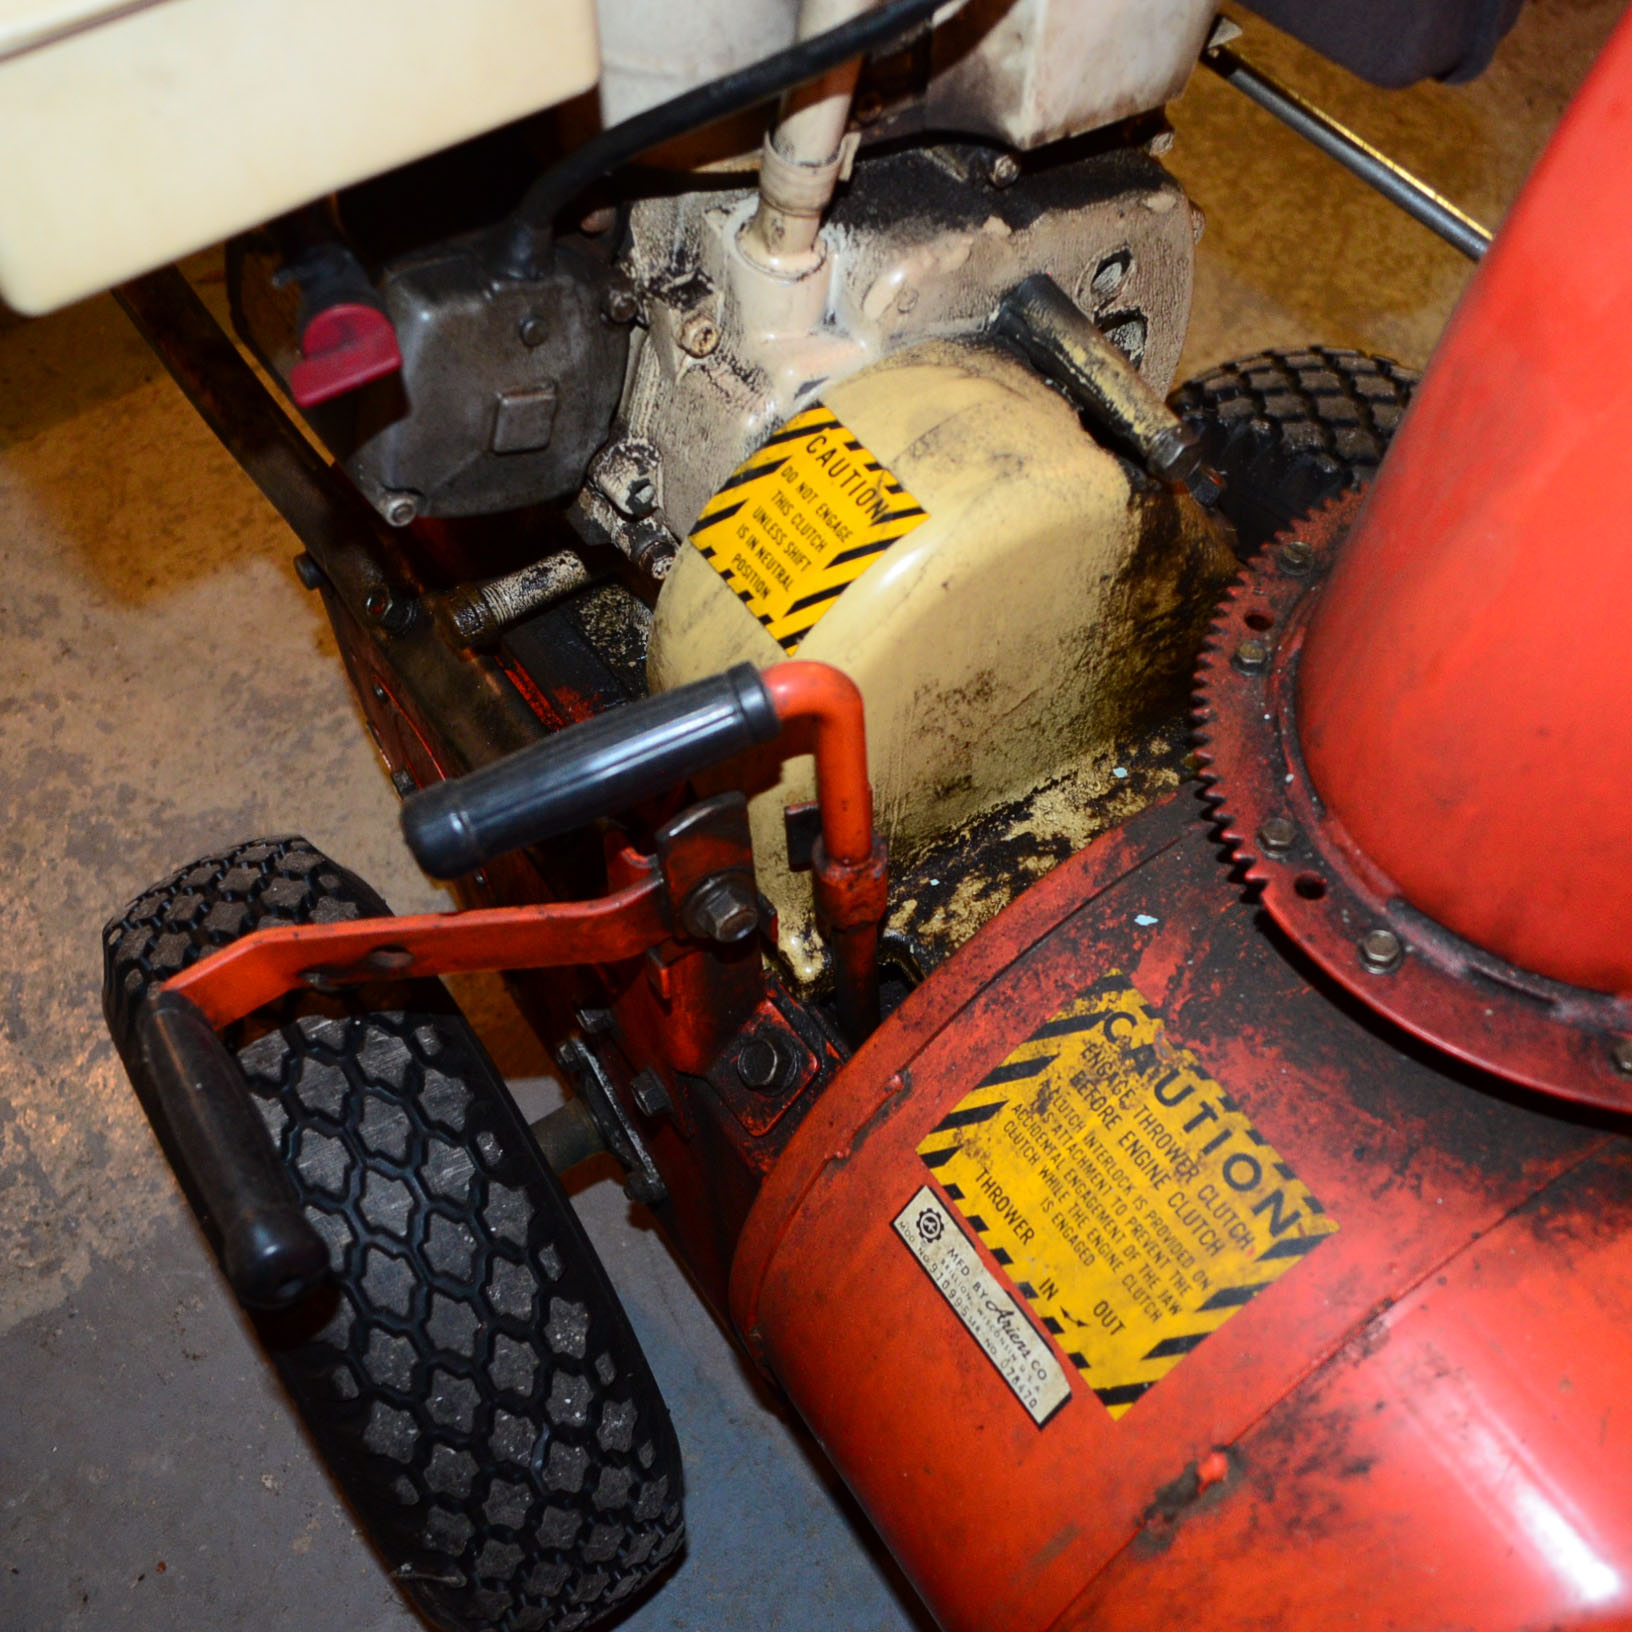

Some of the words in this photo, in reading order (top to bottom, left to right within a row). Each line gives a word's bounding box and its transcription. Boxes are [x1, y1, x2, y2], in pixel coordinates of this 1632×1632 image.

[779, 463, 800, 485] DO
[794, 480, 819, 506] NOT
[813, 501, 854, 544] ENGAGE
[805, 434, 891, 521] CAUTION
[734, 523, 750, 540] IS
[744, 533, 760, 551] IN
[753, 545, 796, 592] NEUTRAL
[750, 504, 789, 546] UNLESS
[782, 540, 812, 572] SHIFT
[769, 489, 795, 516] THIS
[788, 510, 829, 554] CLUTCH
[729, 552, 773, 600] POSITION
[1067, 1068, 1123, 1131] BEFORE
[1117, 1128, 1172, 1192] ENGINE
[1165, 1188, 1225, 1258] CLUTCH
[1079, 1040, 1141, 1112] ENGAGE
[1131, 1103, 1201, 1186] THROWER
[1195, 1181, 1257, 1252] CLUTCH
[1103, 1011, 1302, 1238] CAUTION
[971, 1166, 1036, 1246] THROWER
[1001, 1118, 1042, 1167] CLUTCH
[1036, 1164, 1070, 1203] WHILE
[1065, 1202, 1090, 1229] THE
[1085, 1227, 1124, 1273] ENGINE
[1120, 1272, 1163, 1324] CLUTCH
[1010, 1100, 1069, 1171] ACCIDENTAL
[1061, 1167, 1127, 1246] ENGAGEMENT
[1121, 1243, 1141, 1264] OF
[1136, 1263, 1161, 1289] THE
[1156, 1288, 1183, 1318] JAW
[1038, 1196, 1055, 1214] IS
[1049, 1211, 1097, 1268] ENGAGED
[1047, 1088, 1087, 1134] CLUTCH
[1080, 1129, 1138, 1198] INTERLOCK
[1131, 1193, 1149, 1211] IS
[1143, 1208, 1195, 1270] PROVIDED
[1190, 1267, 1213, 1292] ON
[1050, 1121, 1114, 1199] ATTACHMENT
[1109, 1196, 1129, 1218] TO
[1123, 1214, 1171, 1271] PREVENT
[1167, 1269, 1193, 1298] THE
[946, 1244, 971, 1278] MFD
[971, 1279, 988, 1302] BY
[985, 1300, 1031, 1359] Ariens
[1037, 1276, 1060, 1302] IN
[1090, 1298, 1126, 1339] OUT
